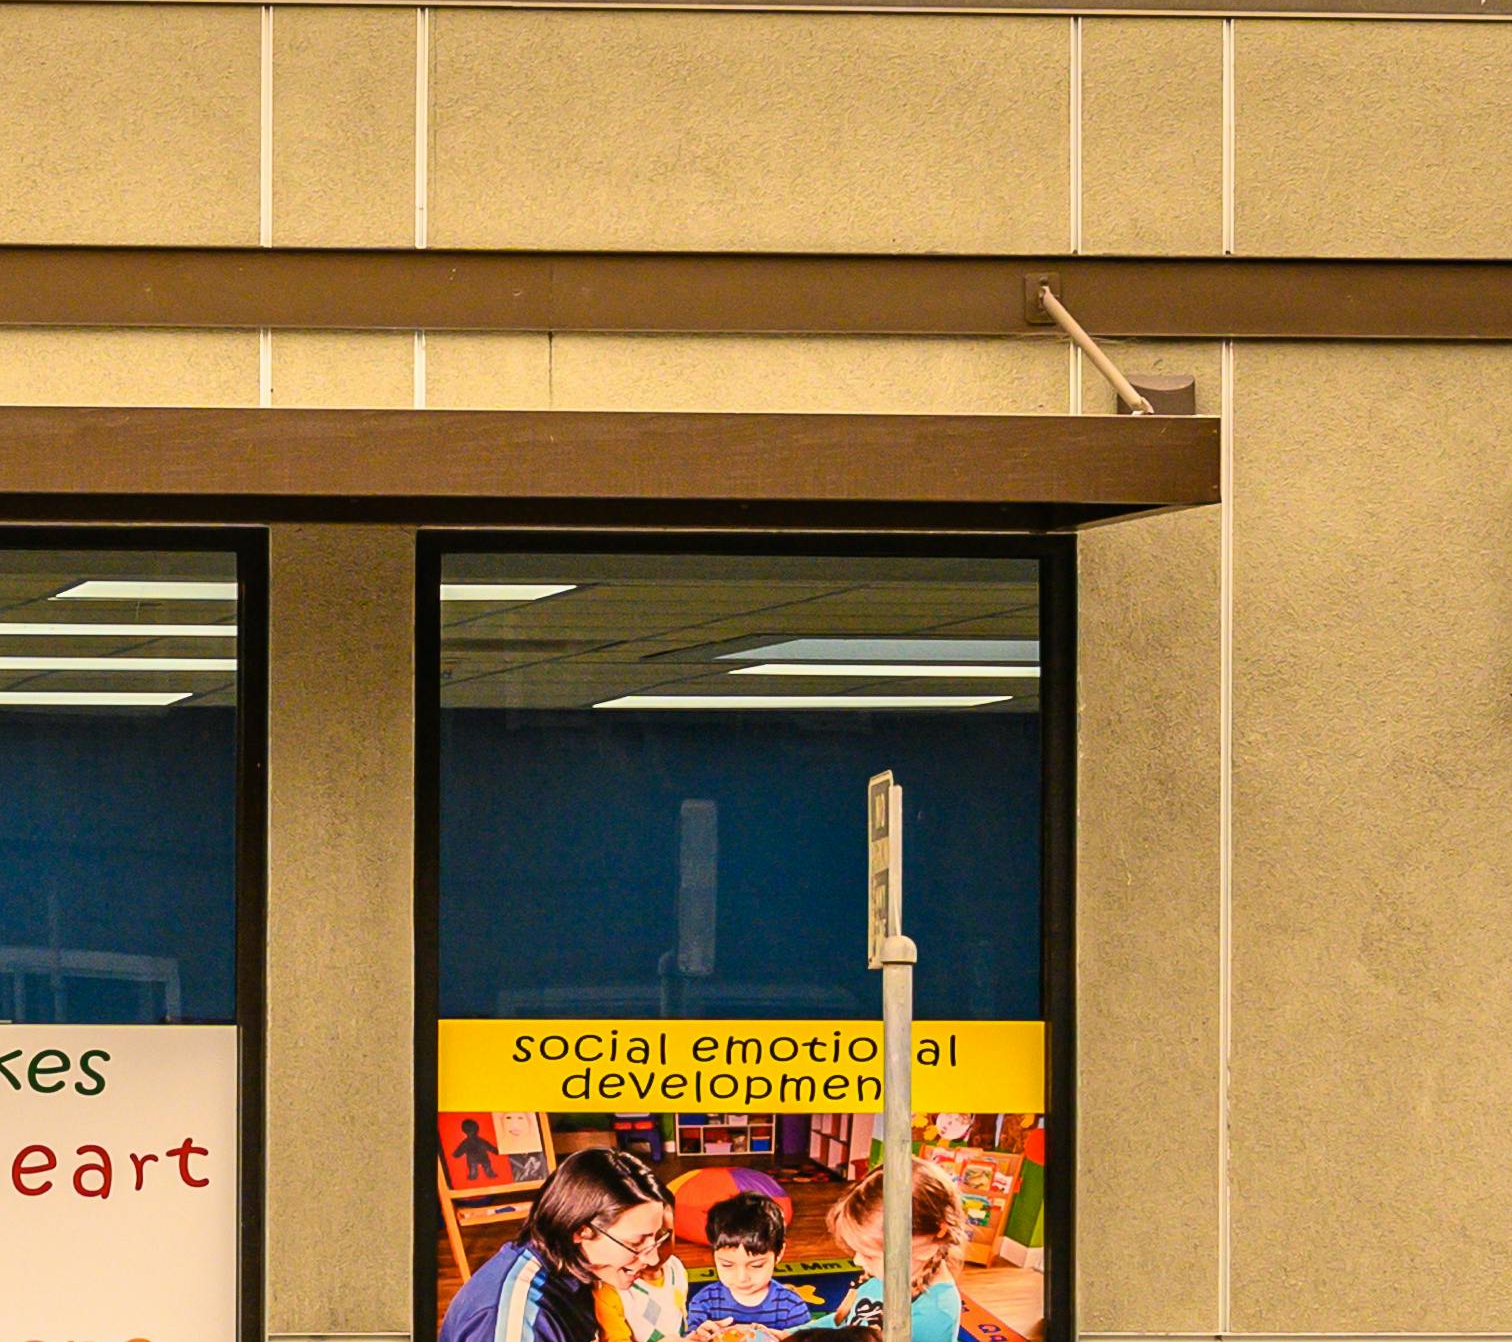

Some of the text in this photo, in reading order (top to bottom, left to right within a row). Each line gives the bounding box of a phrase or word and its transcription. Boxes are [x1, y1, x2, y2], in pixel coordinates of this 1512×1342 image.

[512, 1030, 957, 1067] social emotioal
[561, 1067, 883, 1105] developmen
